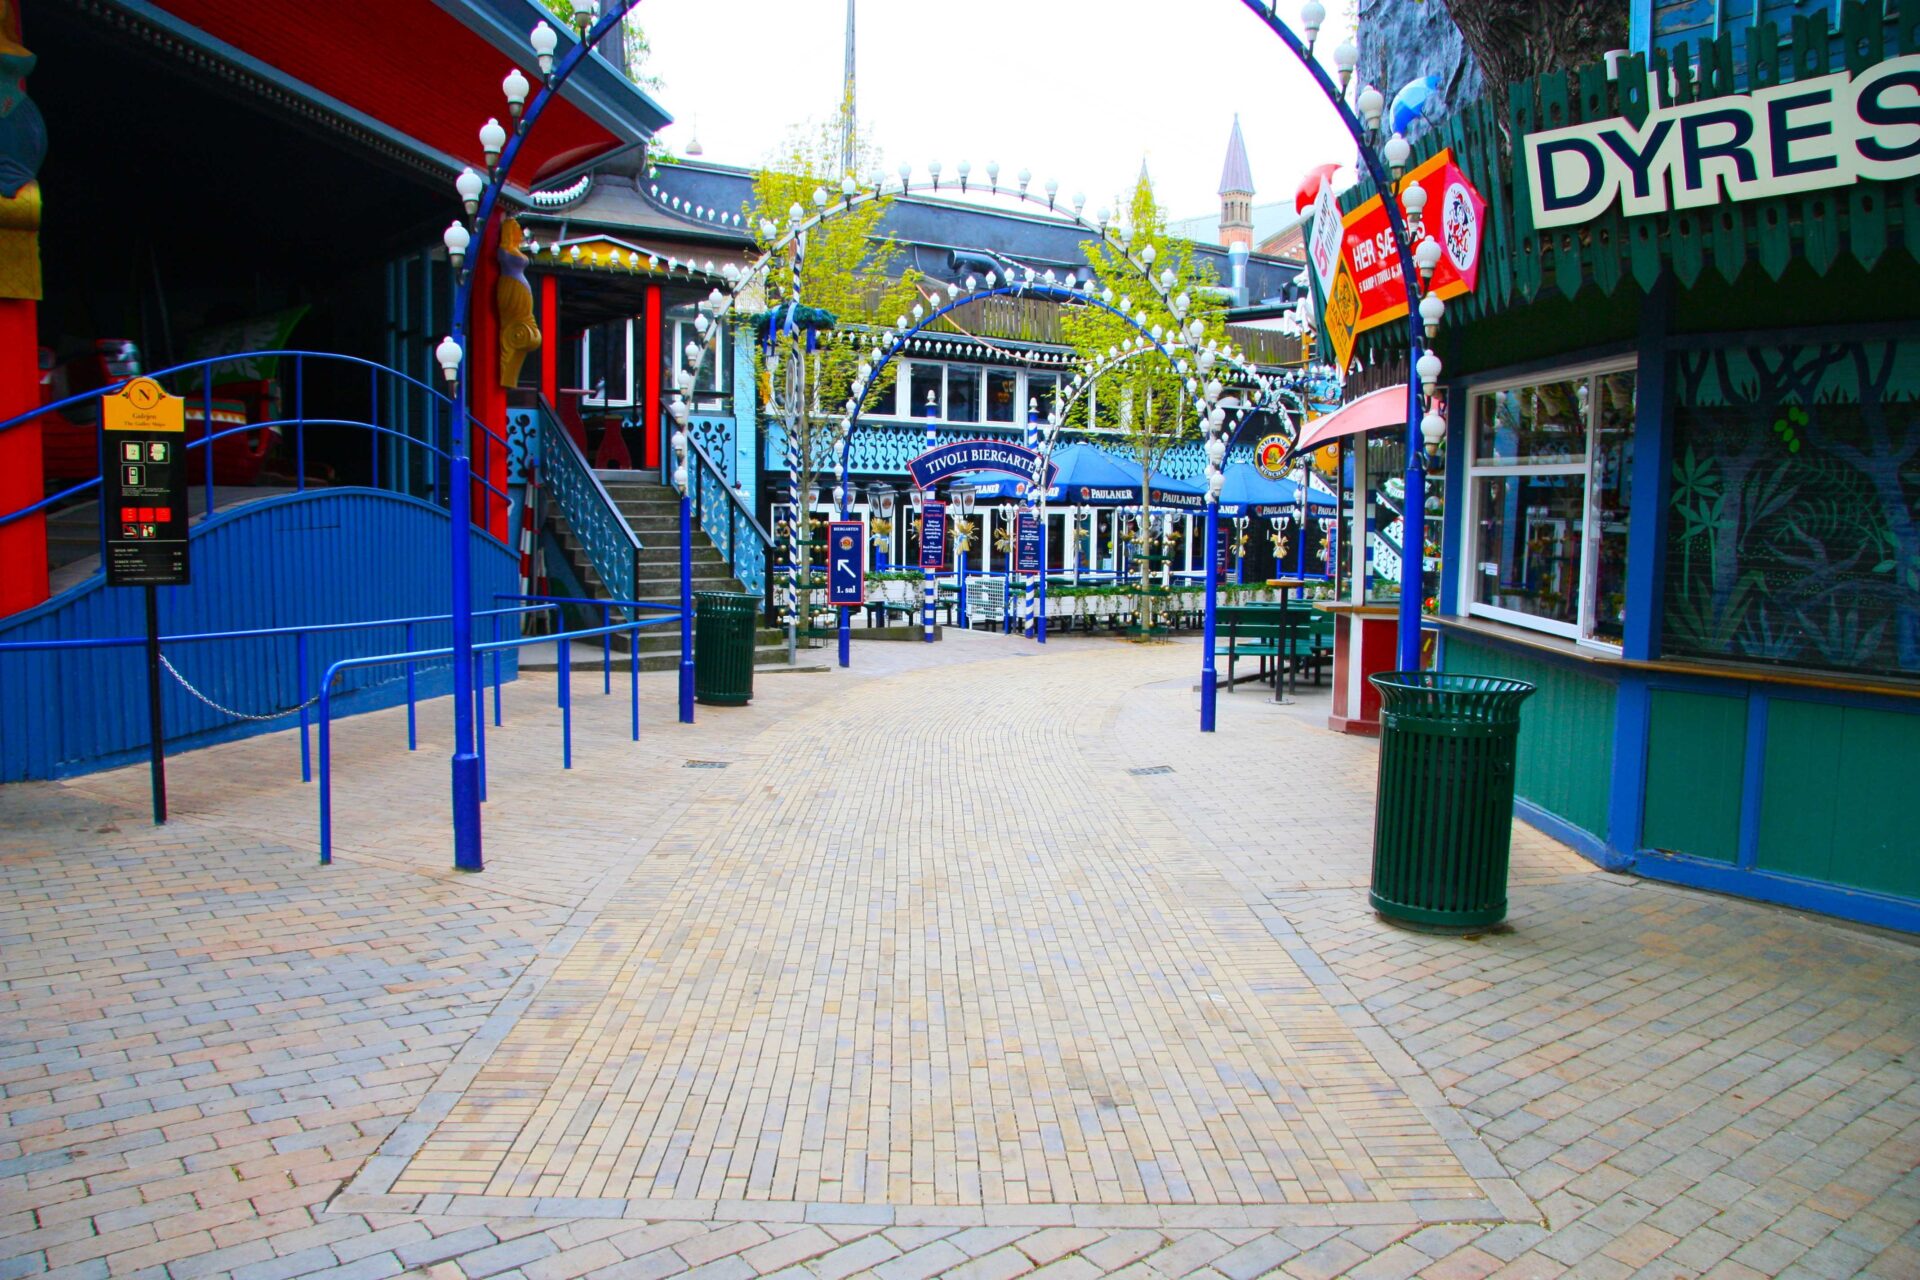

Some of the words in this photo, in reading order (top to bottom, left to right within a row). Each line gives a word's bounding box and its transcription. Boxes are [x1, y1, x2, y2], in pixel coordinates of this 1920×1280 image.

[1536, 70, 1920, 211] DYRES
[1352, 239, 1376, 273] HER
[1258, 437, 1290, 454] PAULANE
[926, 450, 968, 475] TIVOLI
[1091, 488, 1134, 499] PAULANER
[1162, 492, 1202, 506] PAULANER
[1263, 505, 1296, 515] PAULANER
[836, 586, 844, 594] 1.
[845, 585, 856, 594] sal
